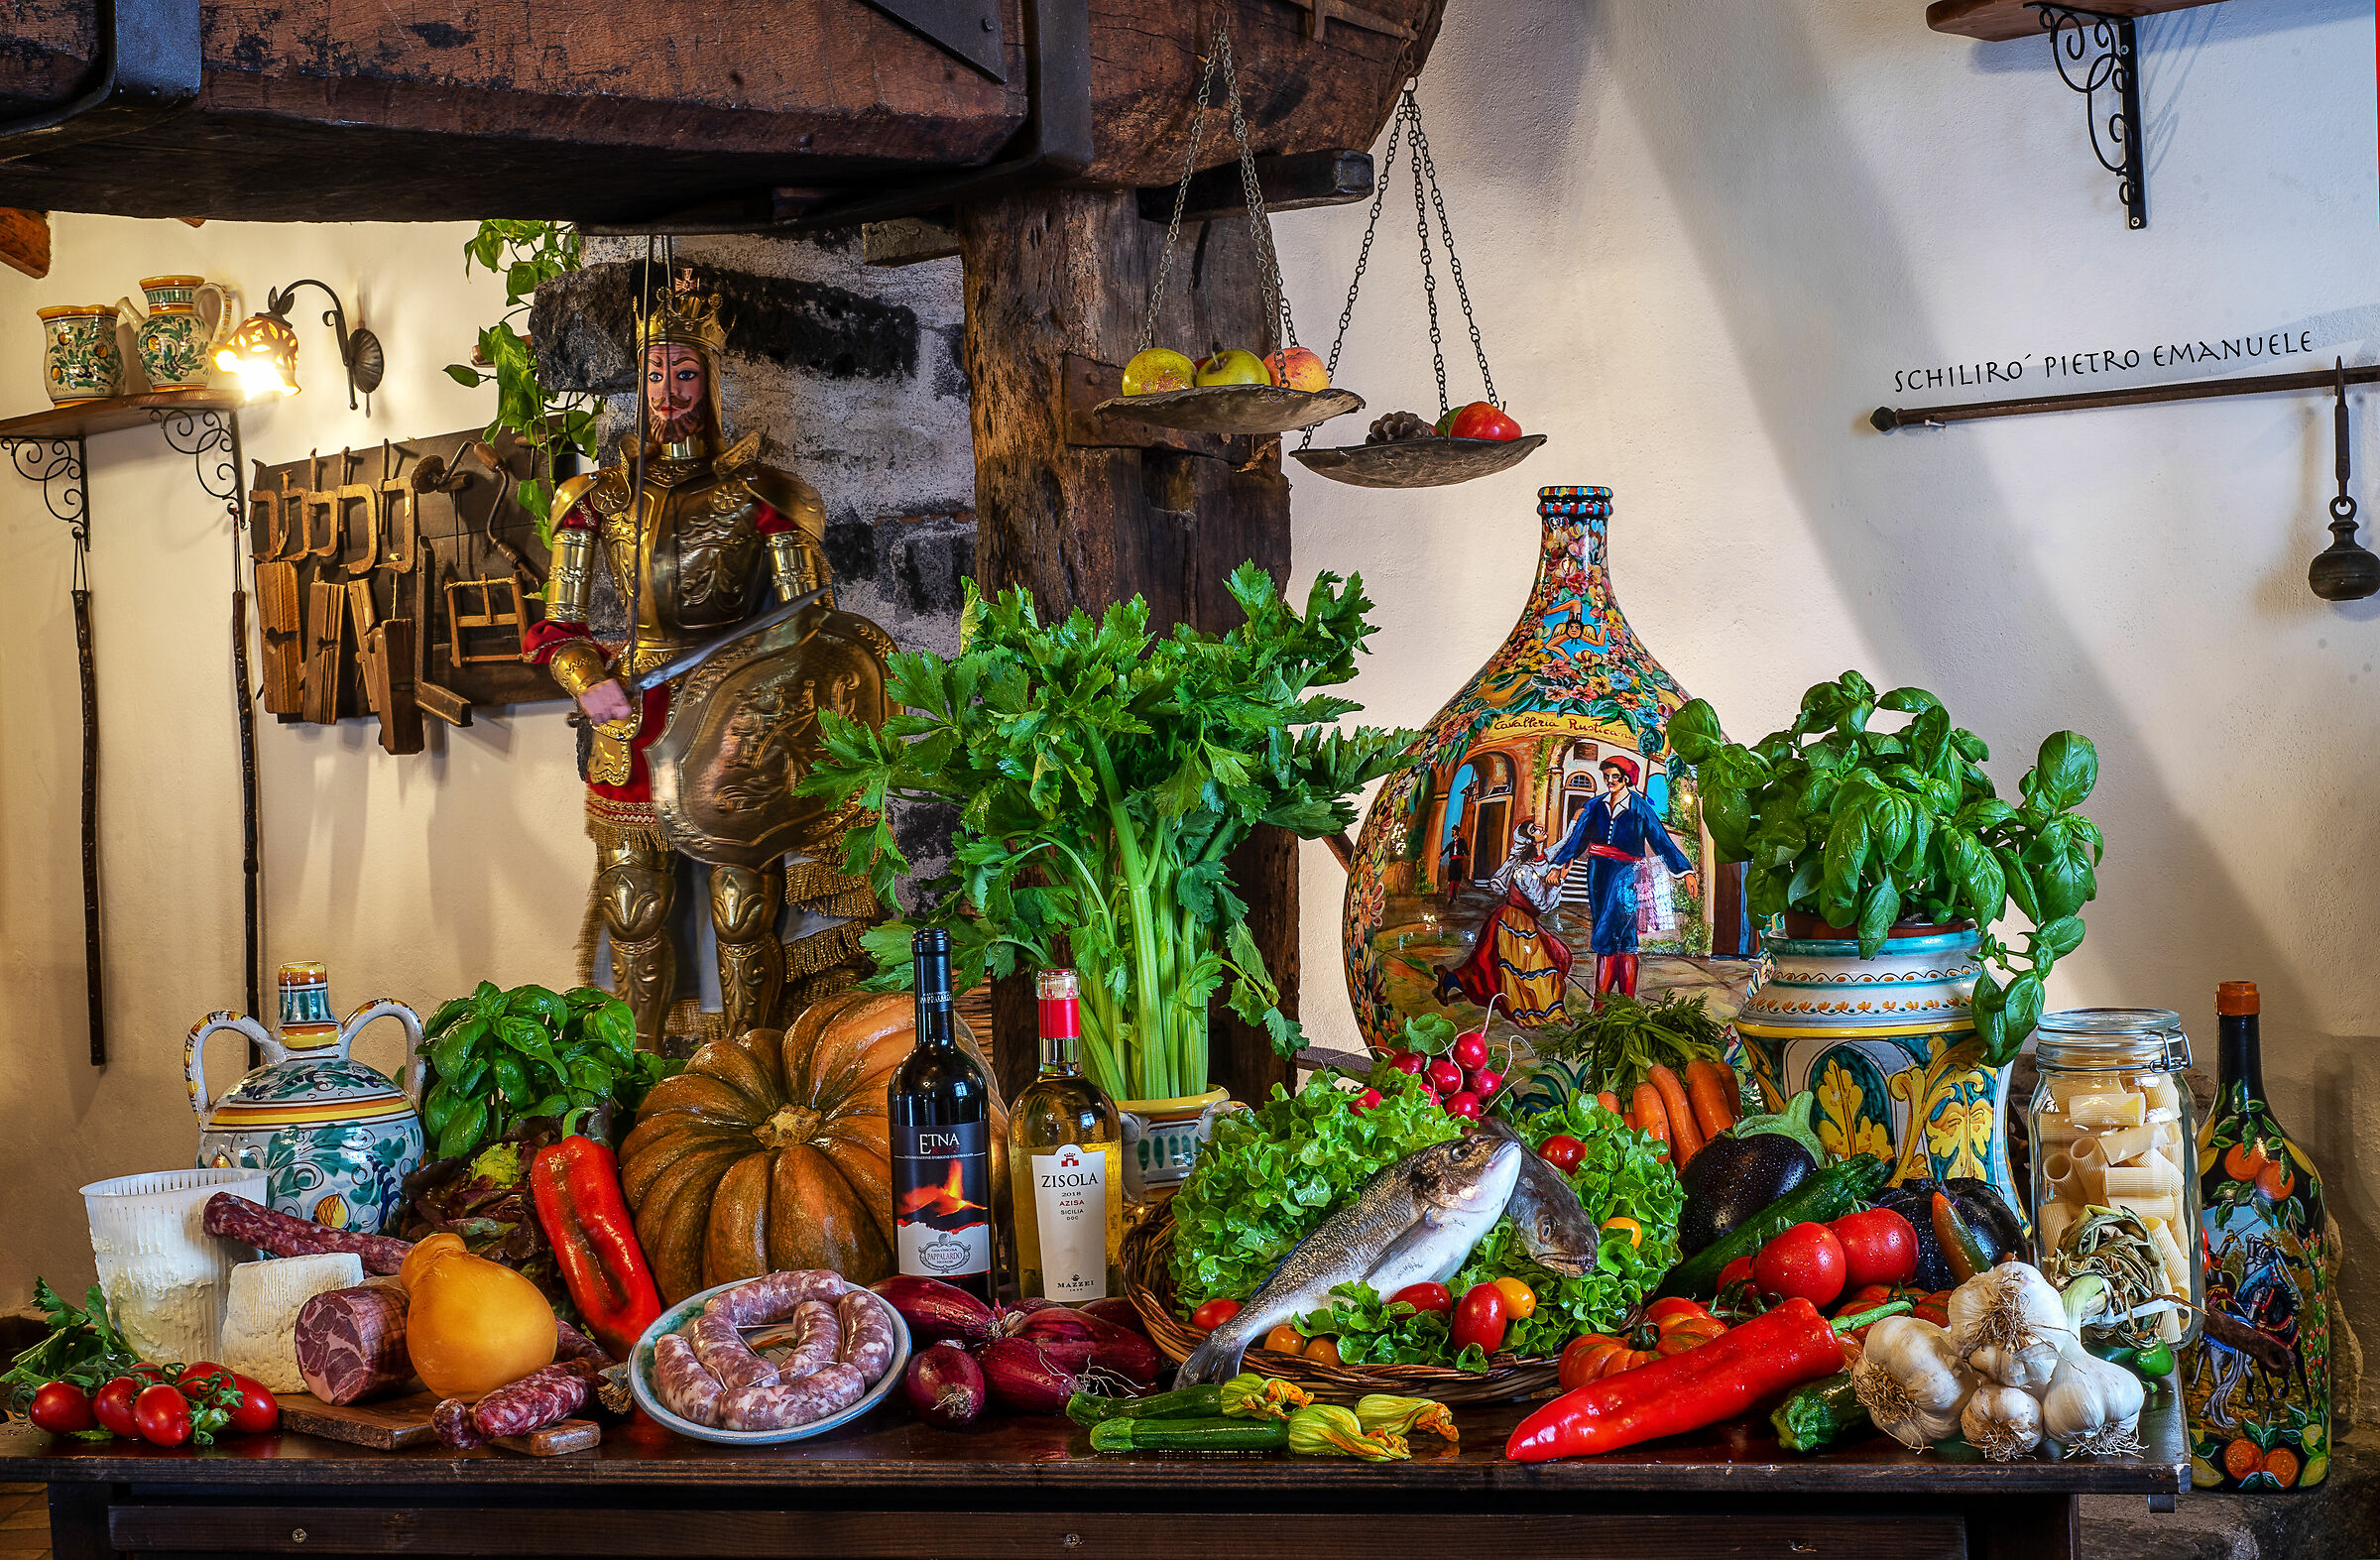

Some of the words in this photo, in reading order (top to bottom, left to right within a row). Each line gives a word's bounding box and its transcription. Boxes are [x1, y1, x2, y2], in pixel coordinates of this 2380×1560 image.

[1494, 717, 1559, 730] Cavalleria
[919, 1133, 960, 1154] ETNA
[1041, 1172, 1099, 1187] ZISOLA
